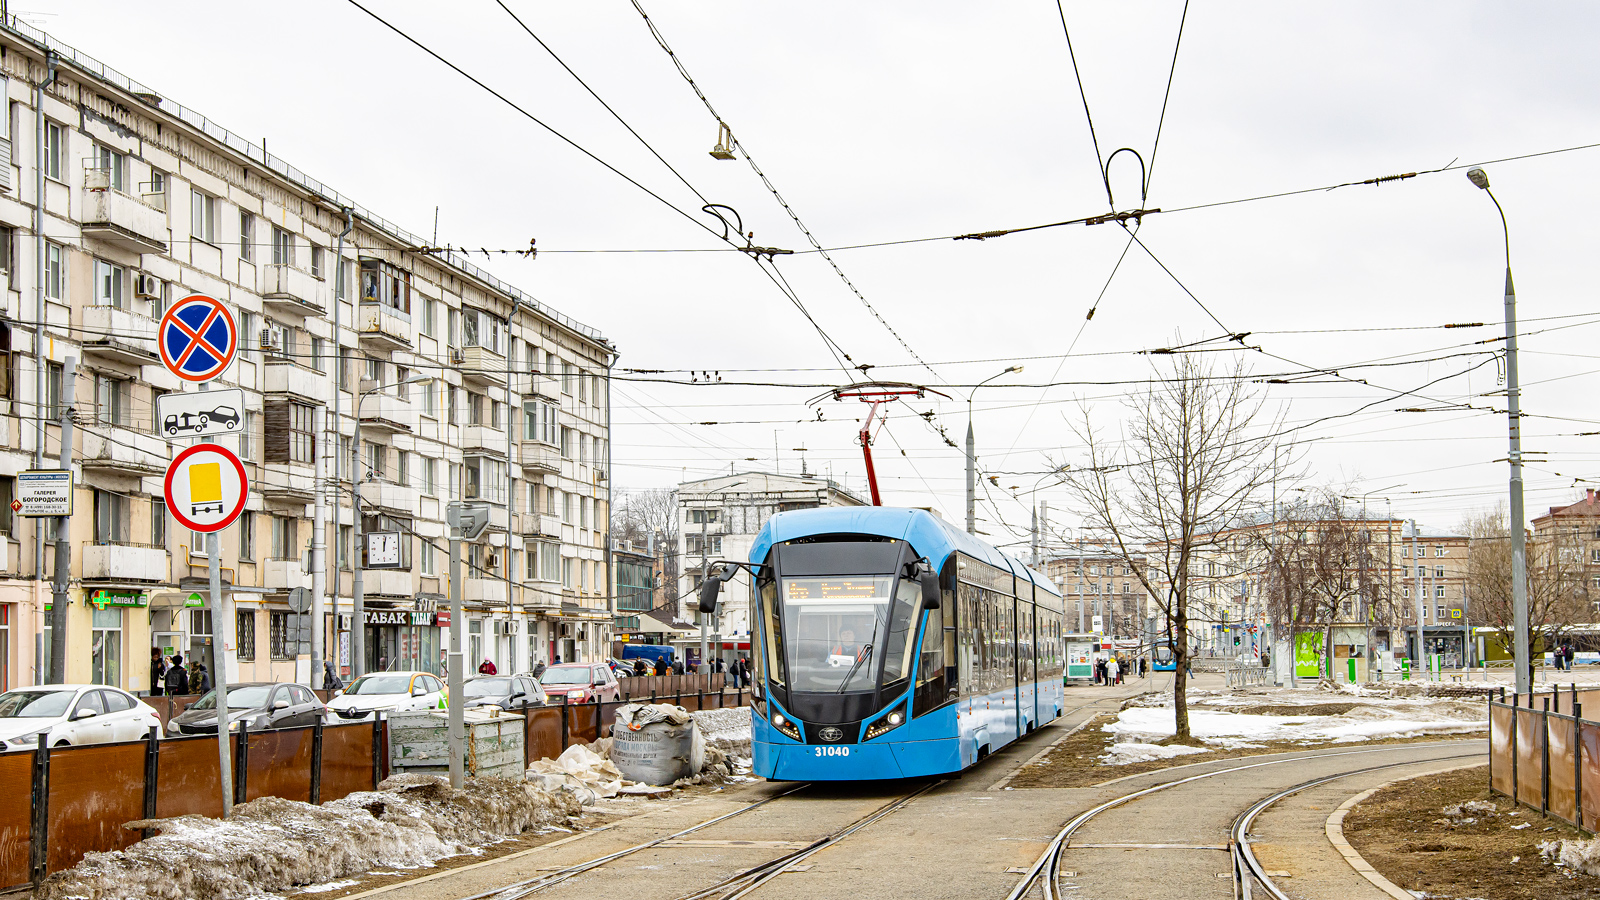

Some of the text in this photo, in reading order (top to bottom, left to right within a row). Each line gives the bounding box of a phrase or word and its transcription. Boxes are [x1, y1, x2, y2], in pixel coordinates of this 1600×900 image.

[364, 612, 406, 624] ТАБАК
[411, 612, 431, 625] ТАБАК
[815, 746, 850, 757] 31040
